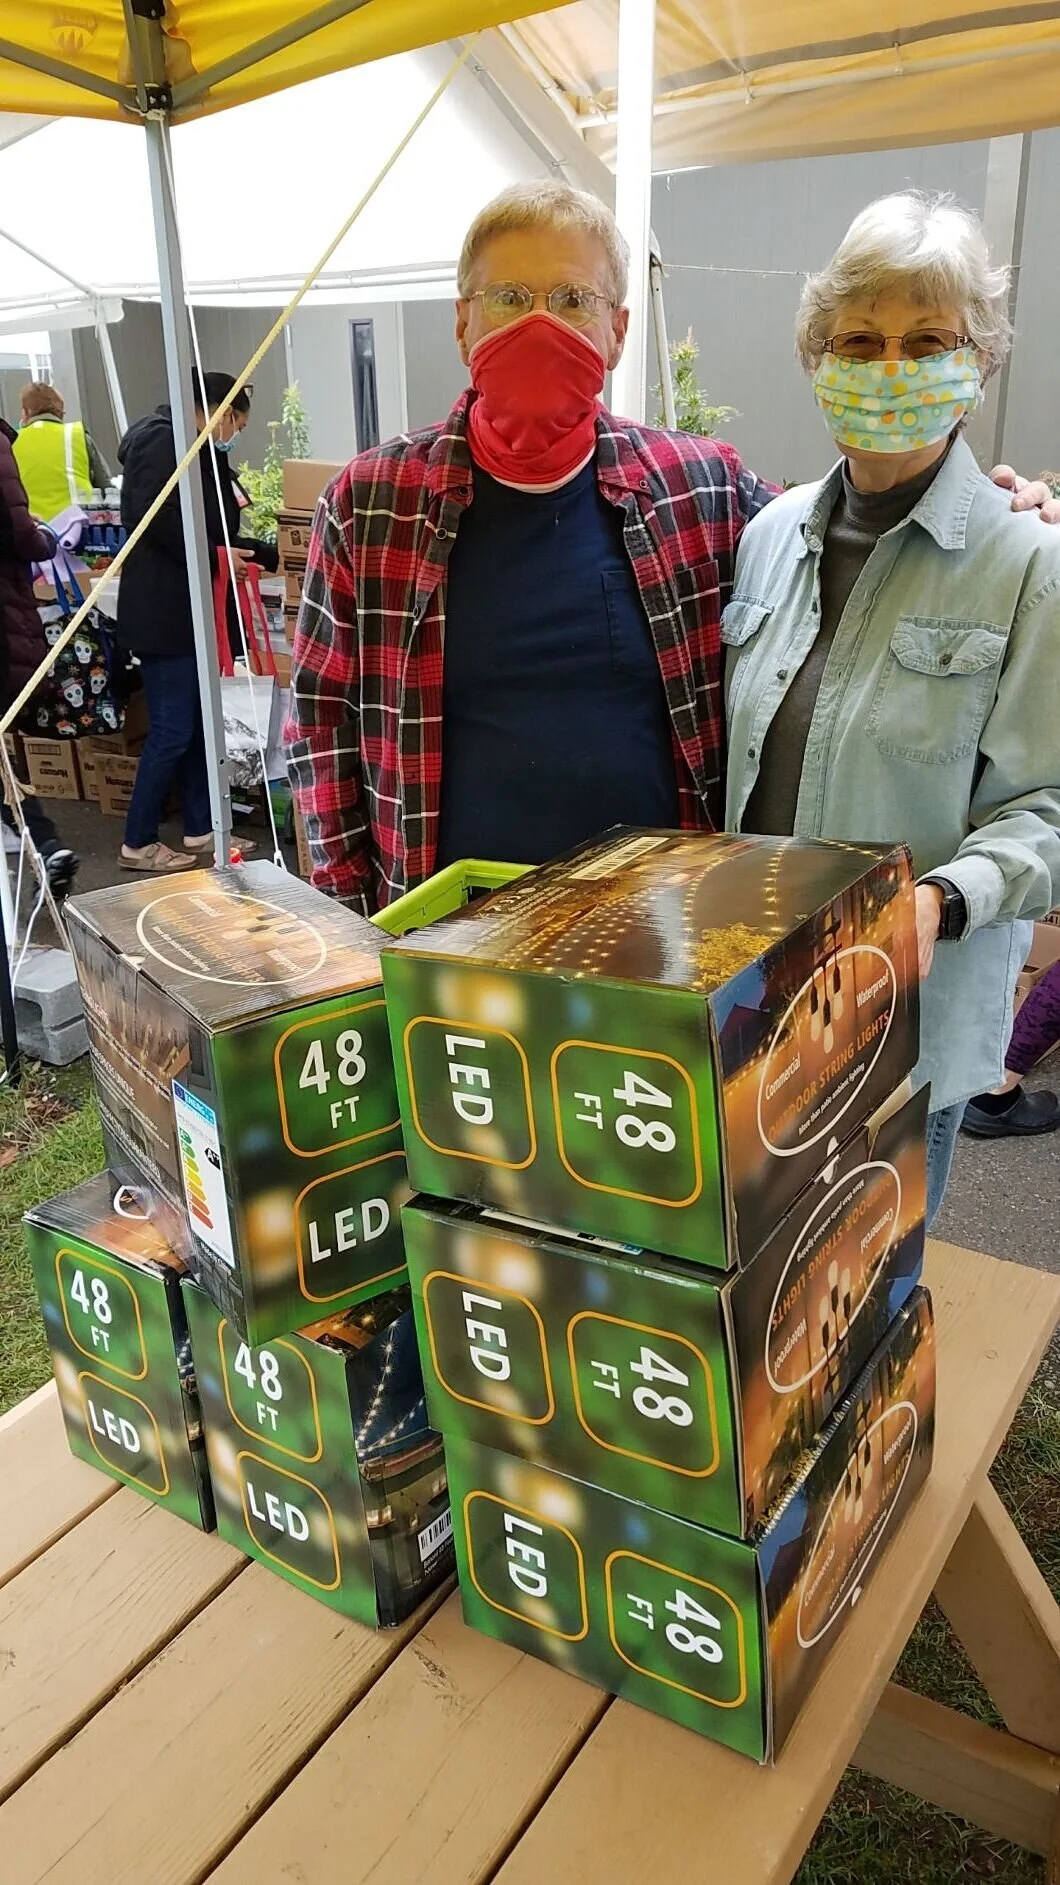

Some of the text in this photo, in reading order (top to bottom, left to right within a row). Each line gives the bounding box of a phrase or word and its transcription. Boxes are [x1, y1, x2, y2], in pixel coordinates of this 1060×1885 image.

[856, 968, 890, 1009] Waterproof
[299, 1029, 367, 1095] 48
[445, 1034, 494, 1126] LED
[765, 1052, 801, 1101] Commercial
[767, 1009, 890, 1144] OUTDOOR STRING LIGHTS
[330, 1095, 361, 1129] FT
[573, 1092, 604, 1131] FT
[613, 1070, 677, 1153] 48
[308, 1198, 390, 1264] LED
[807, 1225, 844, 1280] STRING
[859, 1207, 894, 1254] Commercial
[70, 1268, 113, 1325] 48
[771, 1273, 807, 1332] LIGHTS
[90, 1325, 110, 1353] FT
[461, 1290, 512, 1382] LED
[774, 1317, 808, 1378] Waterproof
[233, 1341, 283, 1401] 48
[590, 1359, 621, 1398] FT
[629, 1345, 694, 1428] 48
[87, 1399, 141, 1454] LED
[256, 1401, 280, 1432] FT
[246, 1481, 310, 1542] LED
[503, 1513, 548, 1598] LED
[626, 1592, 654, 1631] FT
[664, 1588, 725, 1665] 48
